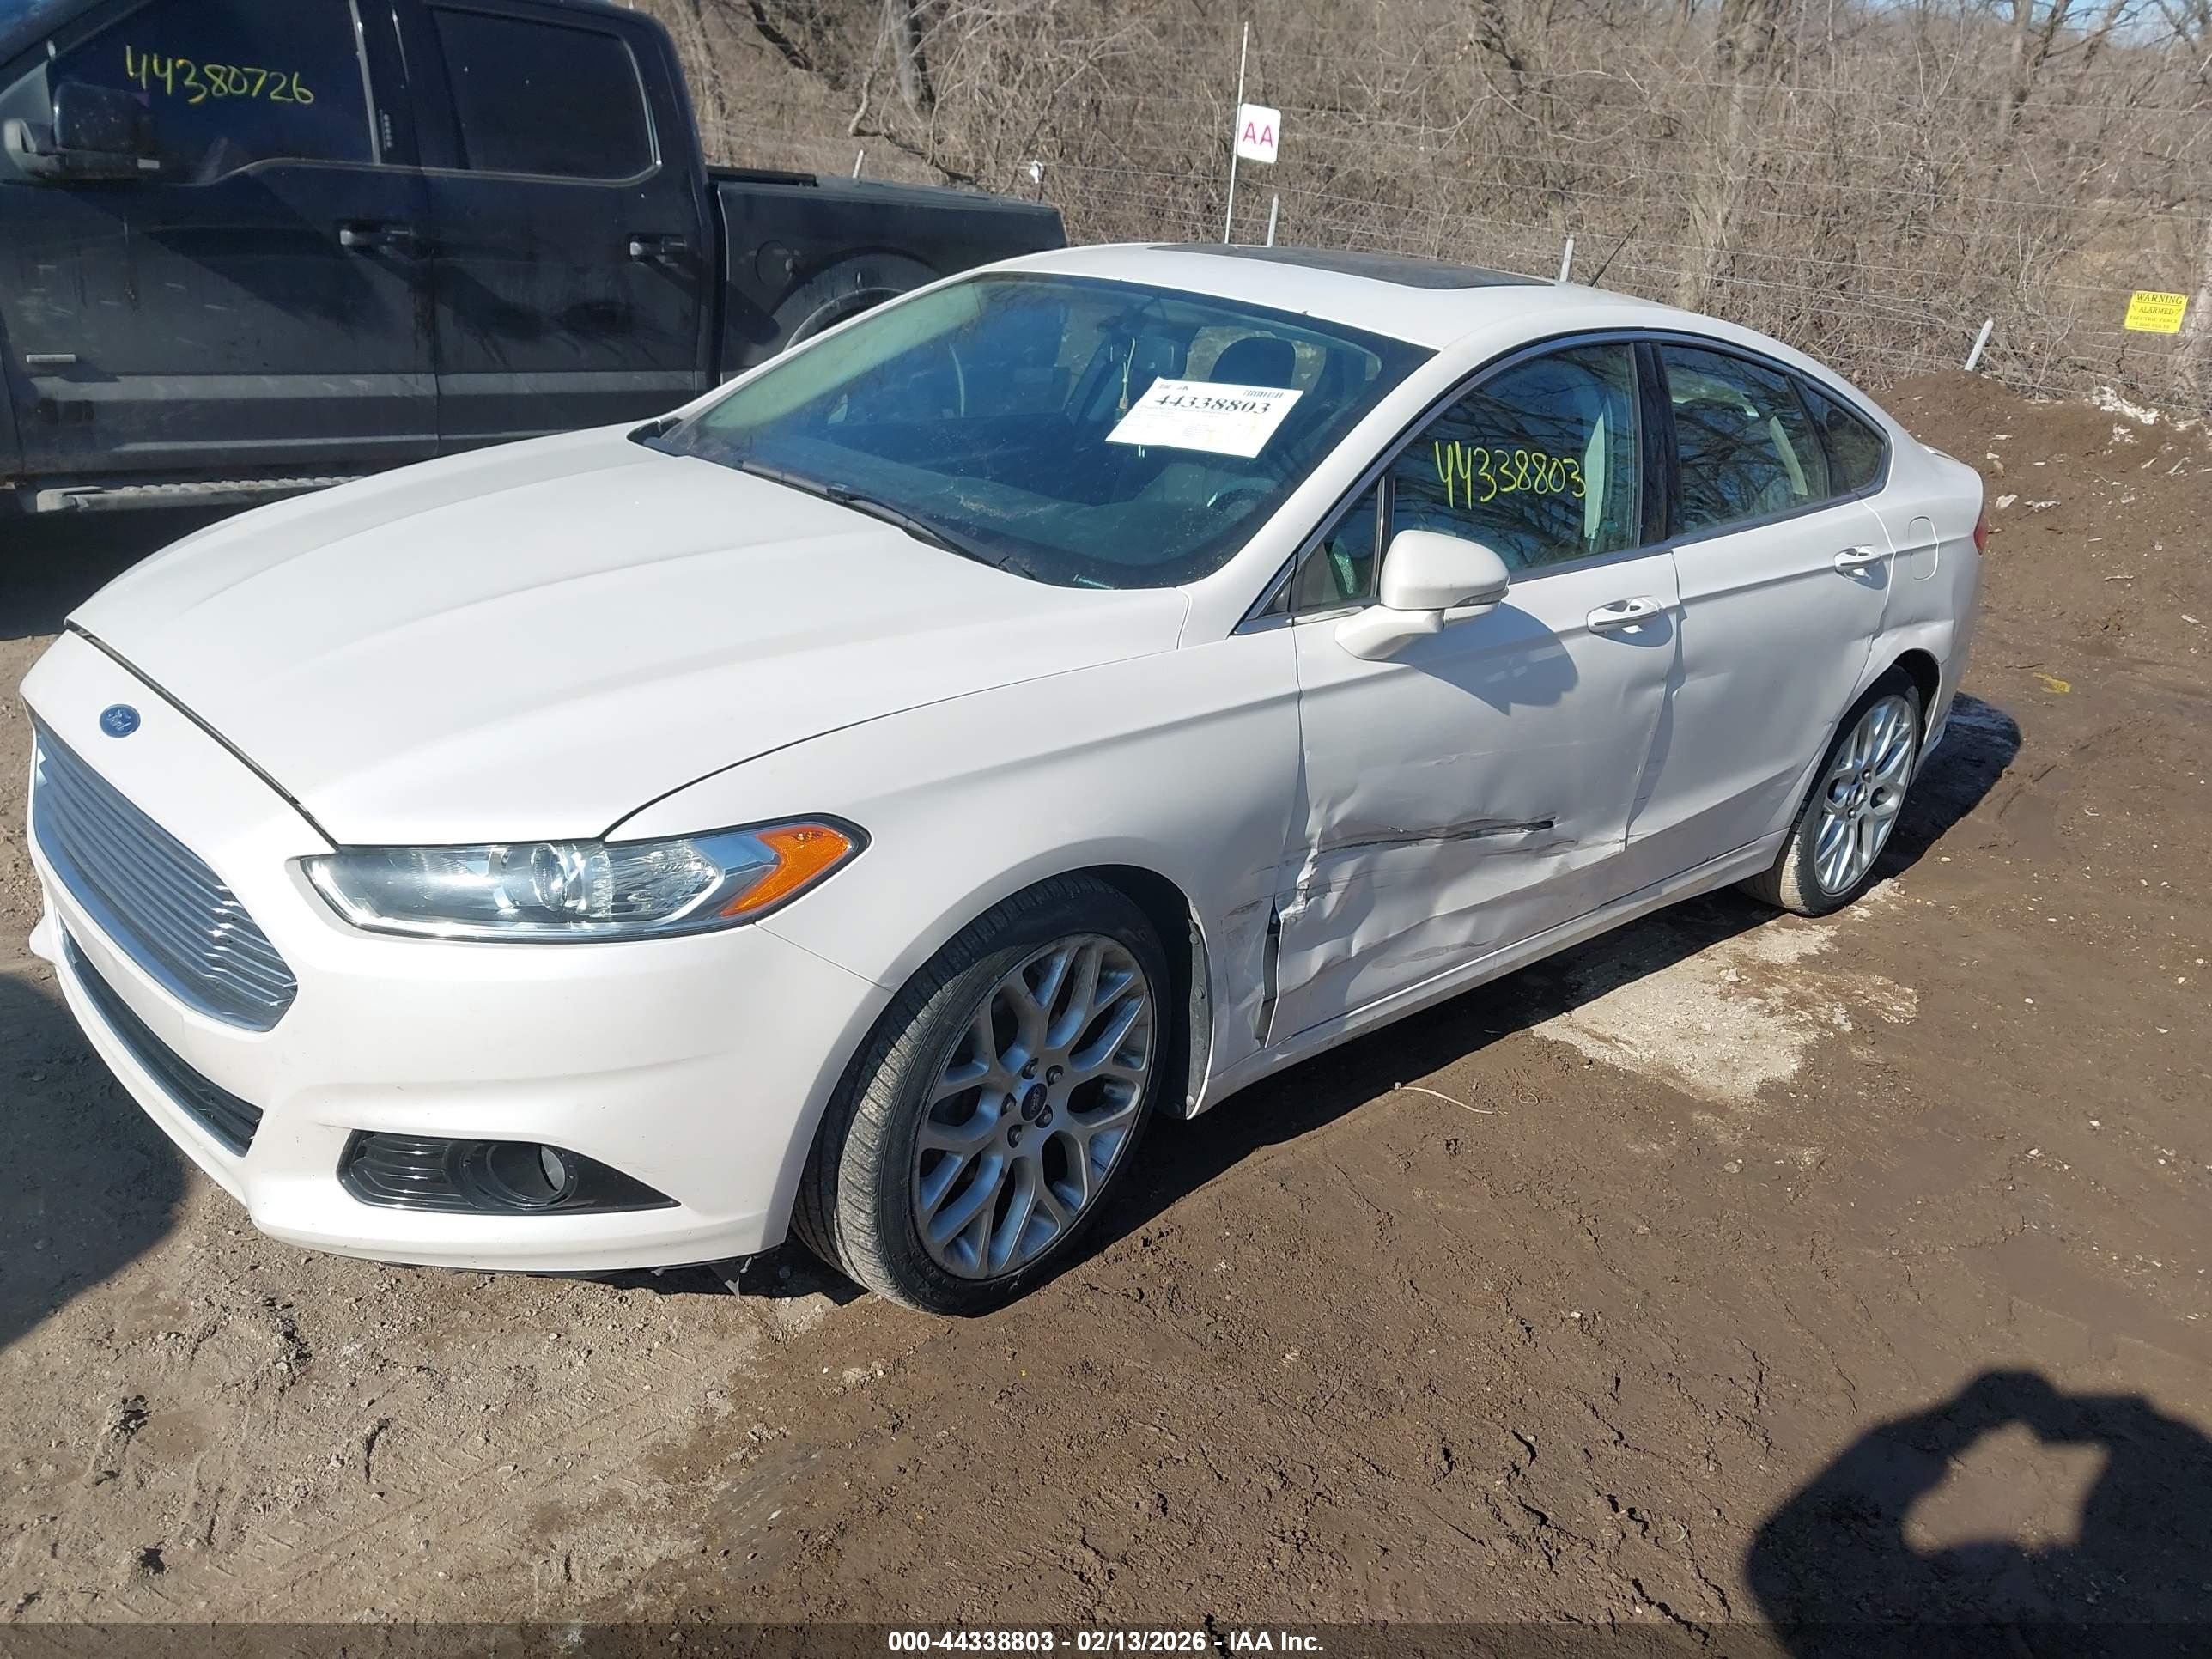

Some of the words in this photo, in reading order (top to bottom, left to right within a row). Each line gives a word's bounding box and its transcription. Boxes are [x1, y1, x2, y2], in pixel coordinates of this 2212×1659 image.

[126, 45, 314, 104] 44380726
[1243, 122, 1273, 148] AA
[2136, 293, 2182, 305] WARNING
[2138, 306, 2174, 315] ALARMED
[1155, 394, 1271, 414] 44338803
[1435, 441, 1587, 510] 44338803
